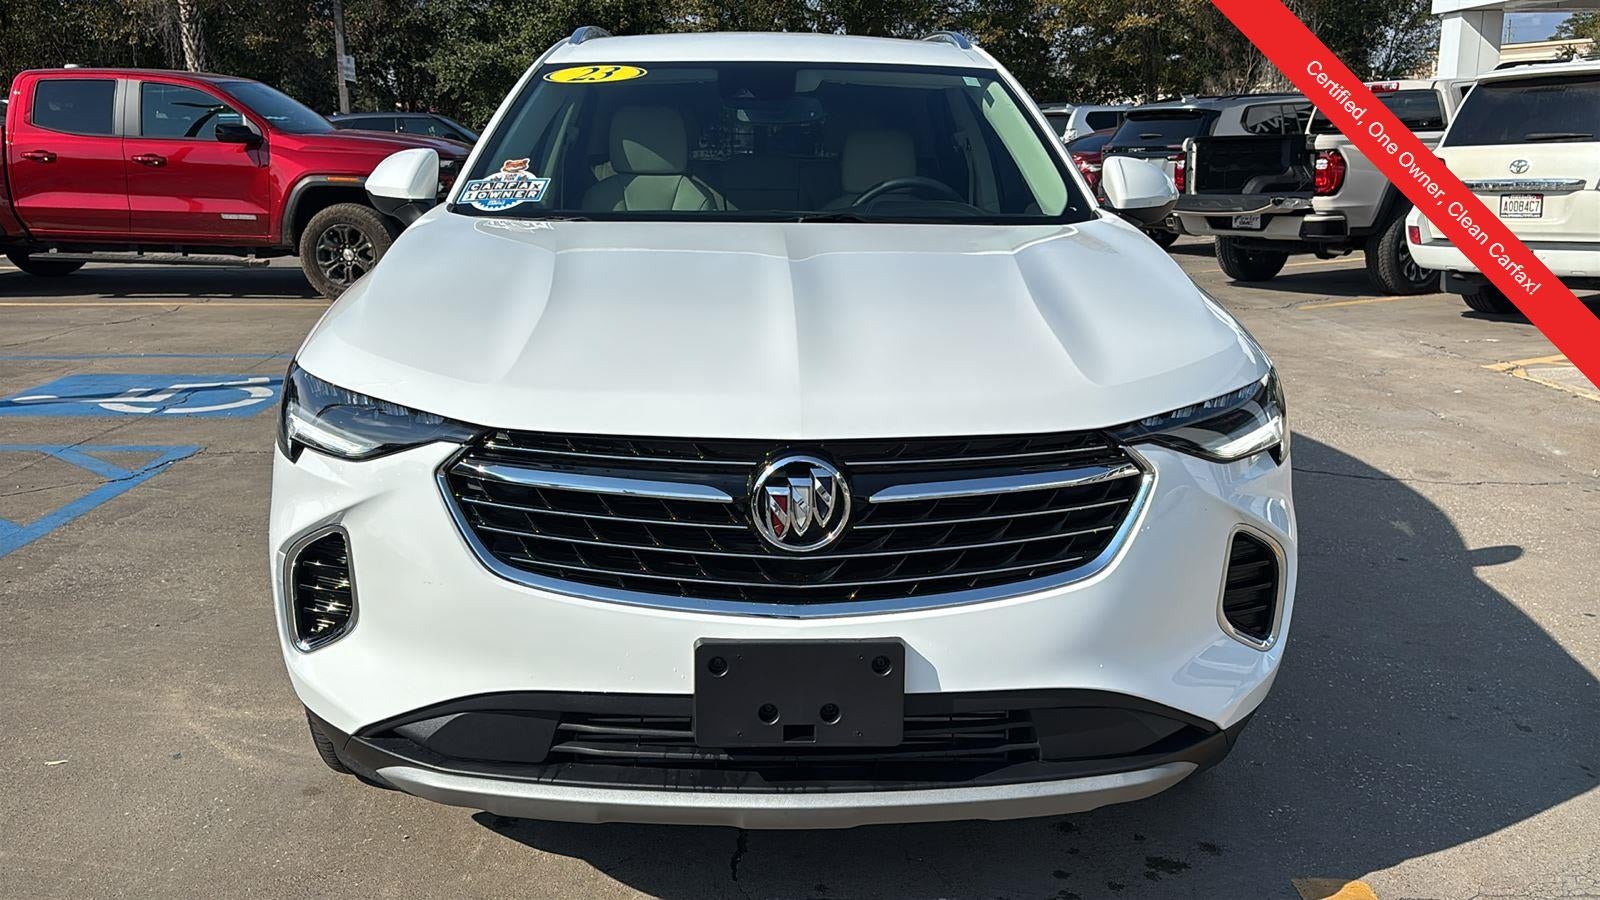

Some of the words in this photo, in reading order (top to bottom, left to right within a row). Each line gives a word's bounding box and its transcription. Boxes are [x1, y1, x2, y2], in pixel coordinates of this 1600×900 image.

[566, 66, 622, 81] 23
[470, 182, 541, 191] CARFAX
[477, 190, 538, 199] OWNER
